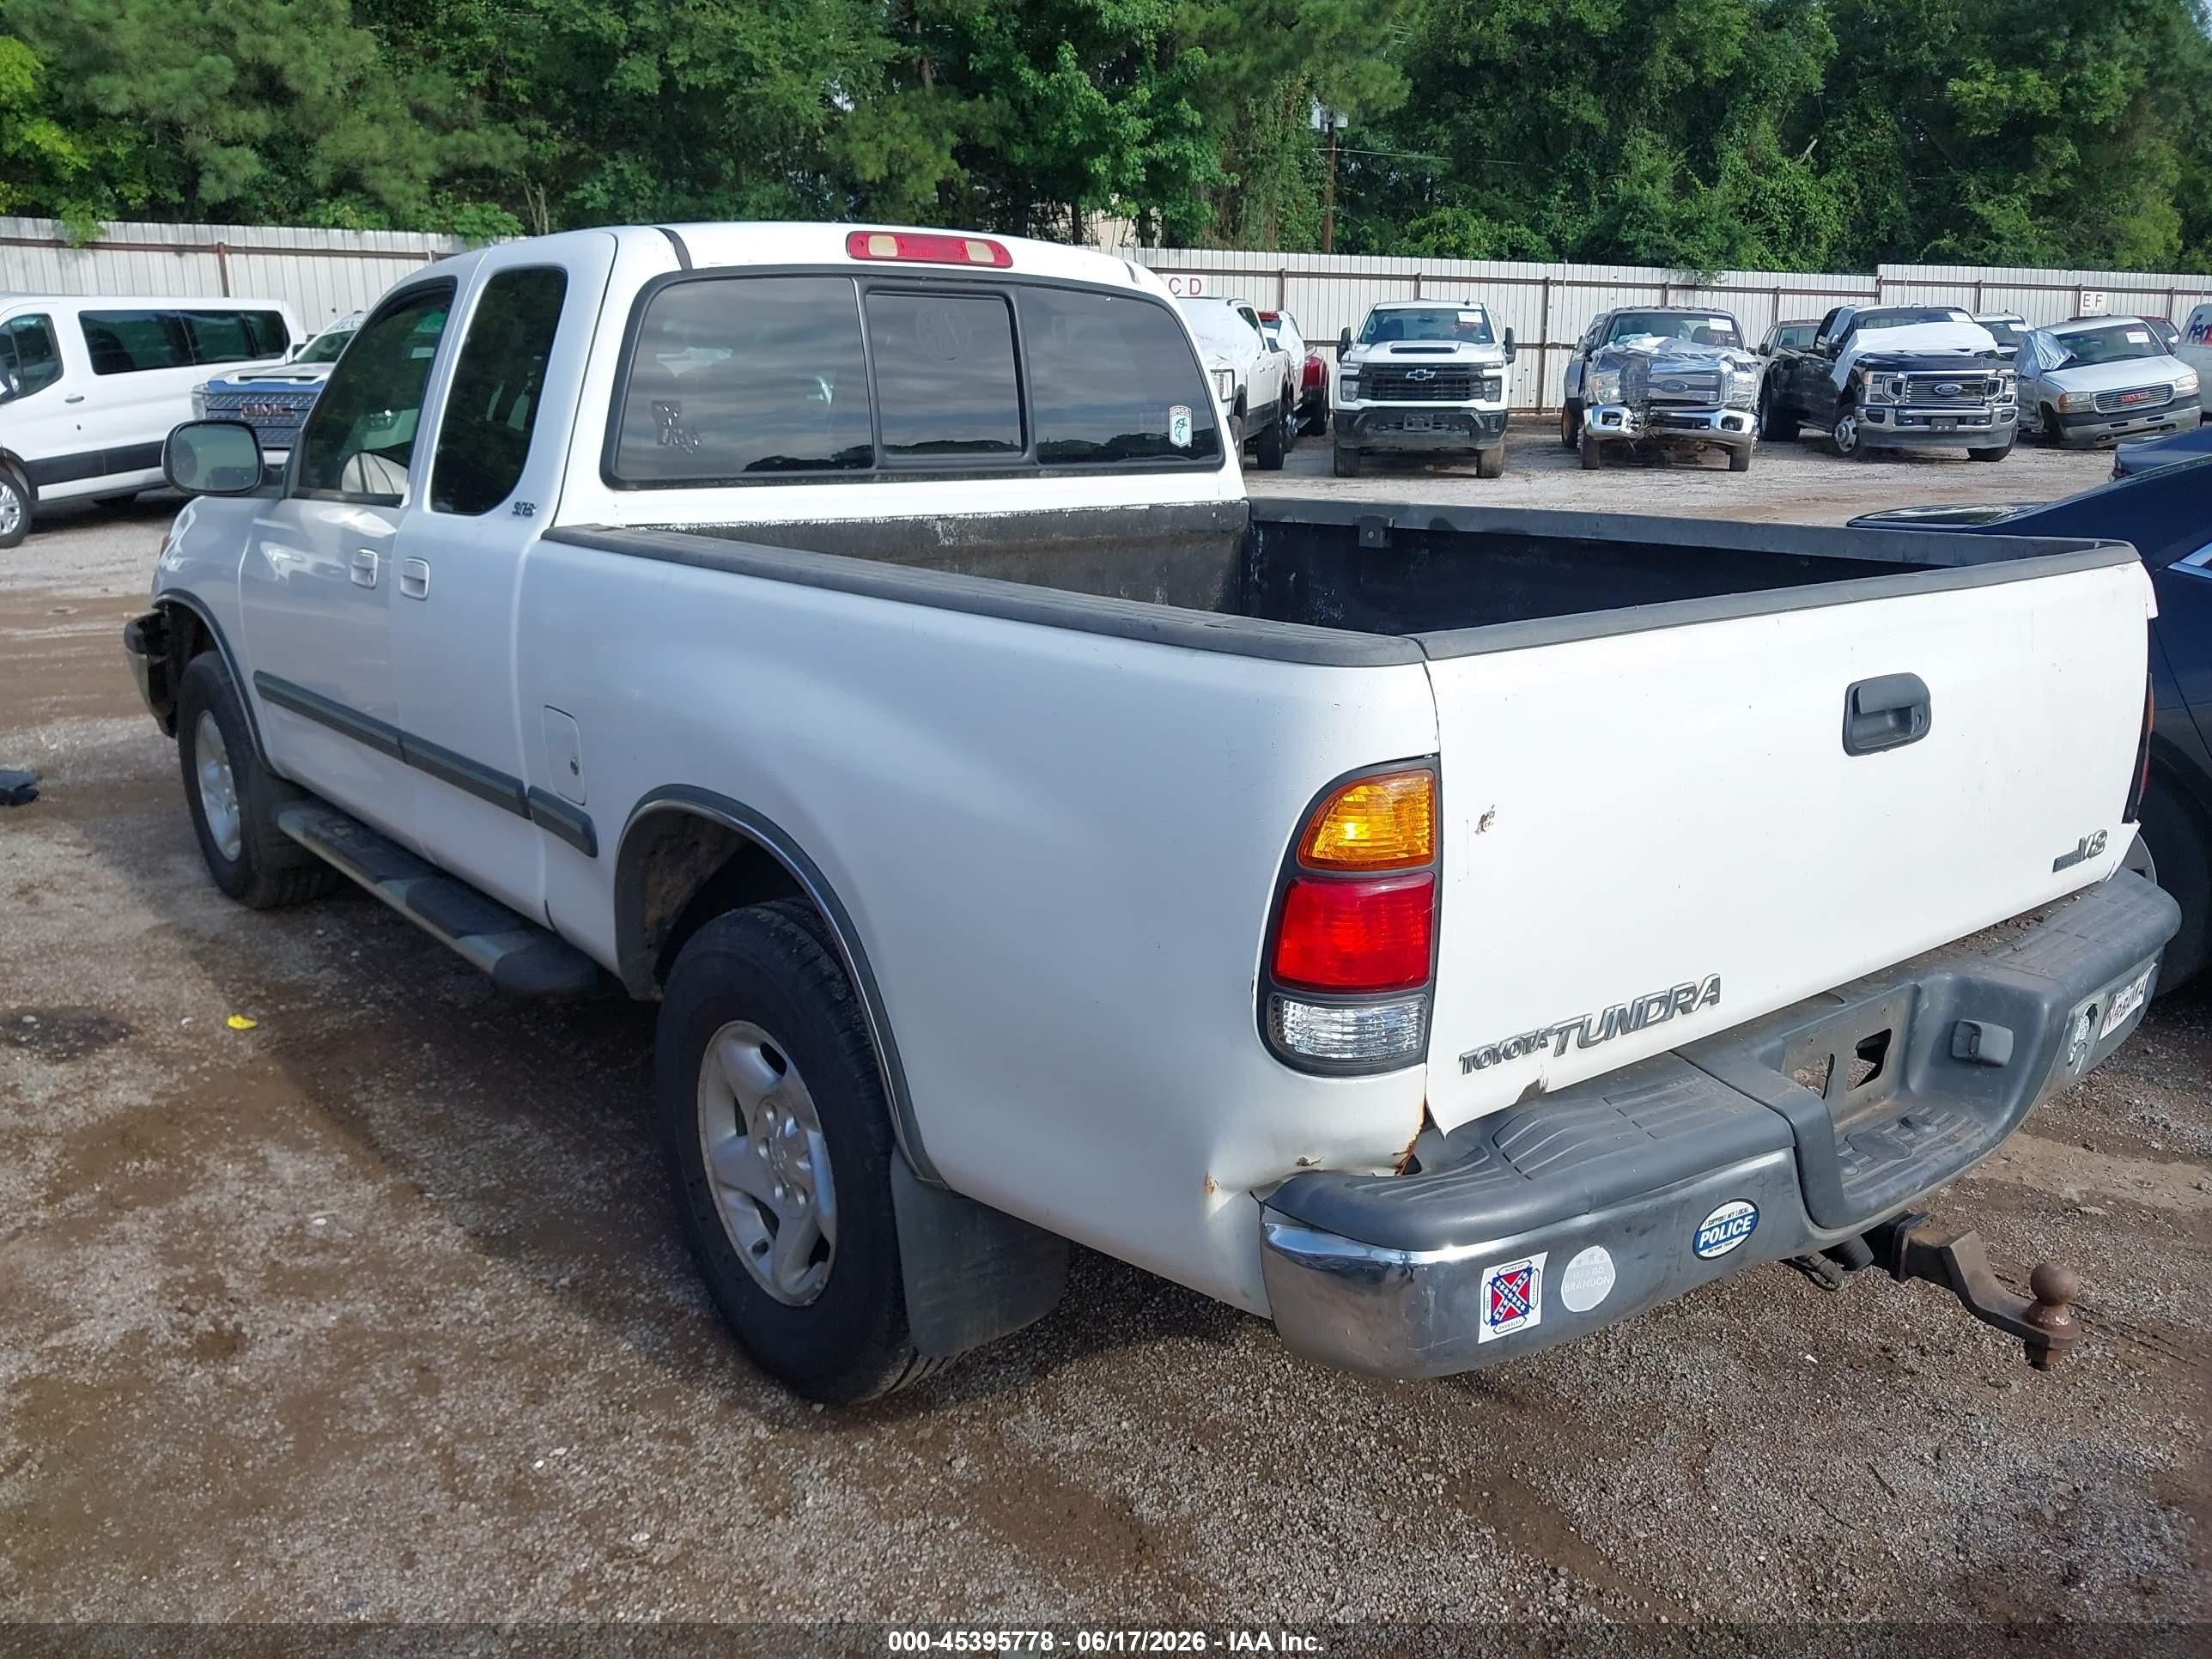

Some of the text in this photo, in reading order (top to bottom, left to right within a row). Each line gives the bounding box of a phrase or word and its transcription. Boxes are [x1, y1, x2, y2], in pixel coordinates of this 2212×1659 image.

[1169, 277, 1201, 295] C D
[2083, 294, 2103, 308] E F
[2185, 314, 2212, 344] Fed
[2078, 829, 2108, 861] V8
[1458, 973, 1722, 1074] TOYOTA TUNDRA
[1708, 1214, 1726, 1226] SUPPORT
[1735, 1206, 1749, 1216] LOCAL
[1698, 1215, 1753, 1249] POLICE
[1592, 1266, 1605, 1275] GO
[1565, 1275, 1611, 1292] BRANDON
